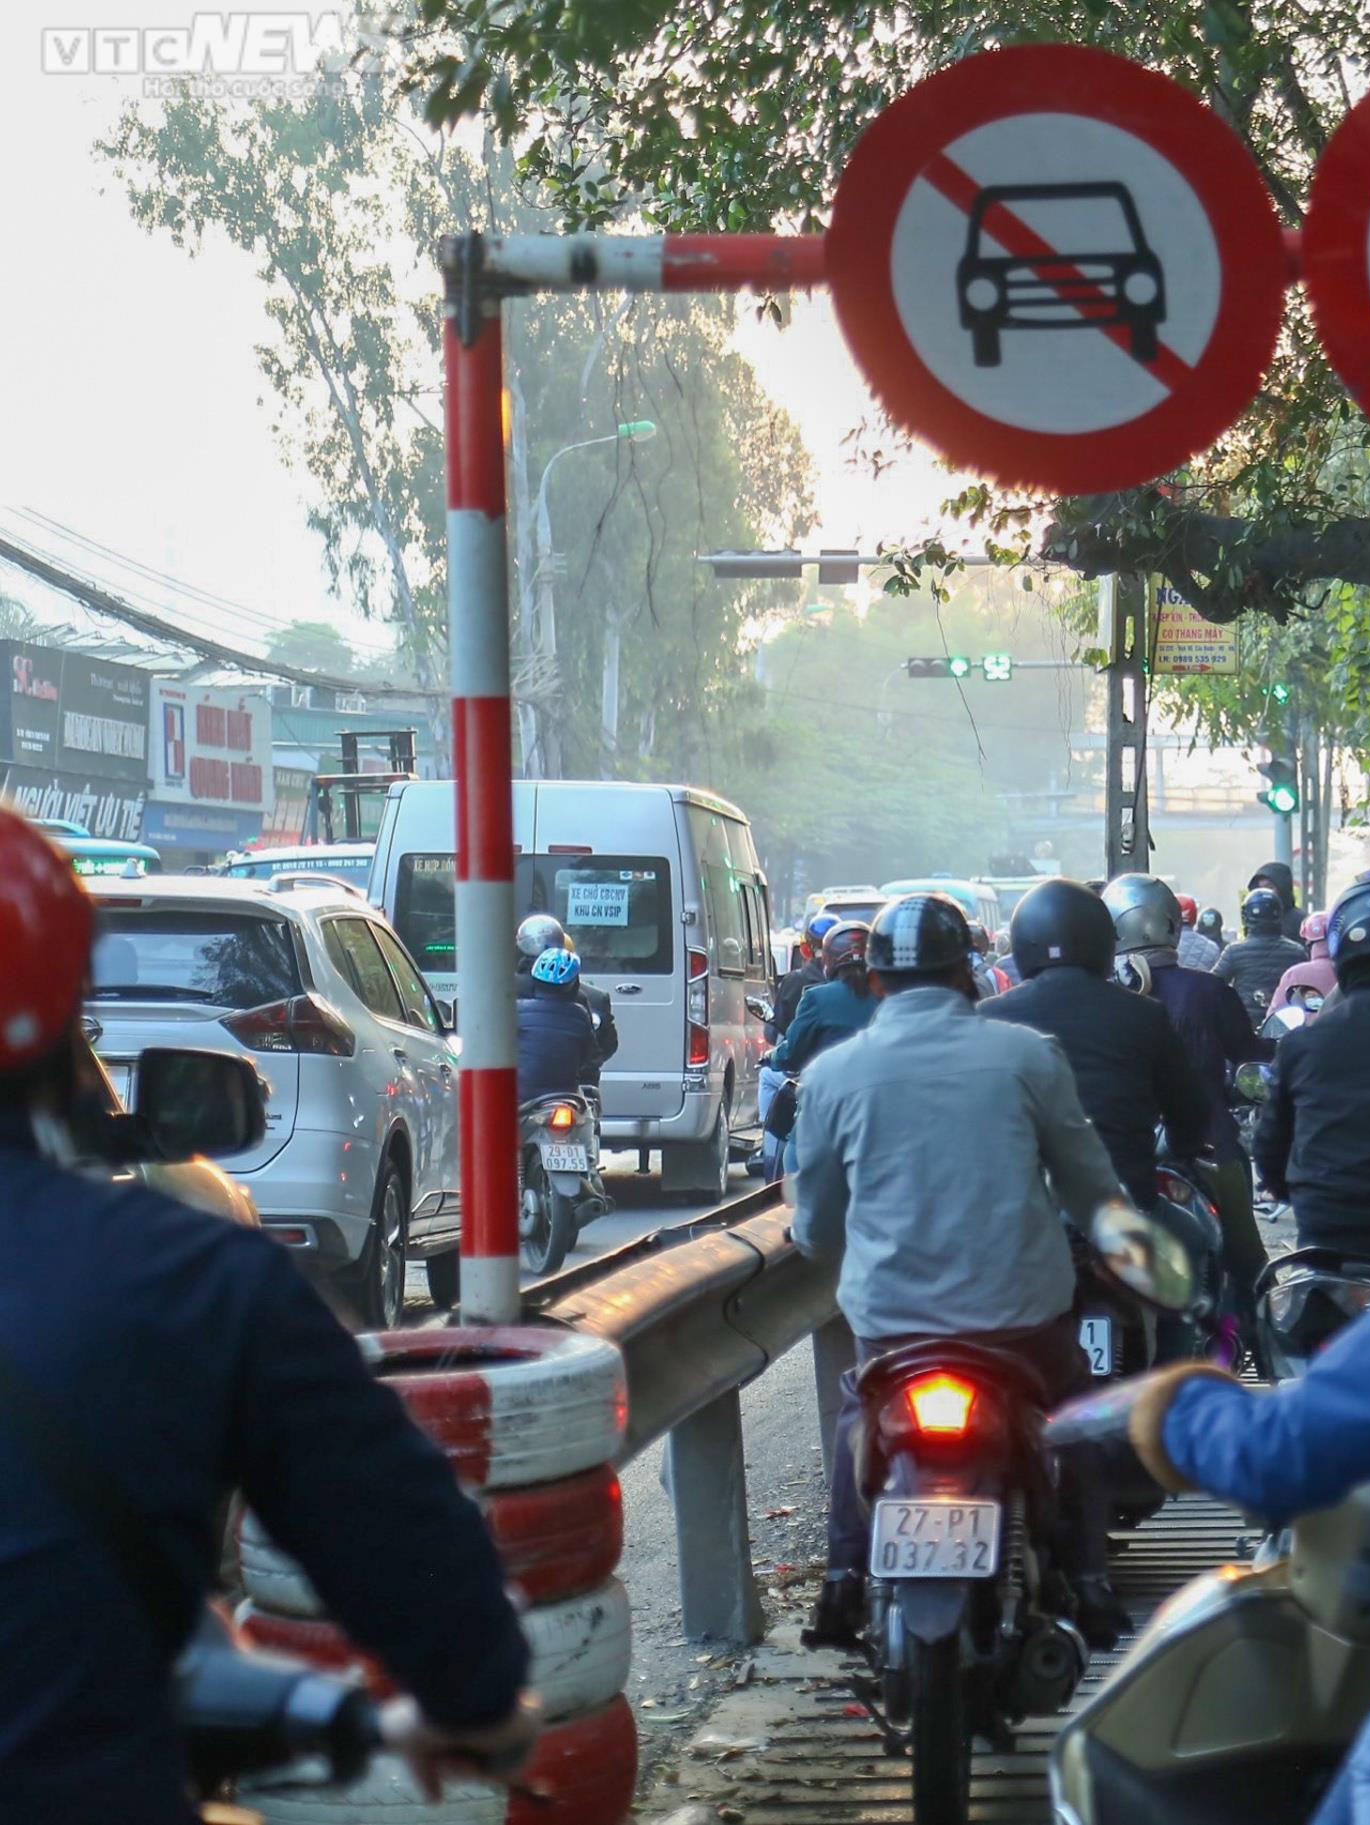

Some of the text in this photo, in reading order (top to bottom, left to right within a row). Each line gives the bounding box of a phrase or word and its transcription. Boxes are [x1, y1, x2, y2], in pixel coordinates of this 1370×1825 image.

[546, 1158, 586, 1170] 097.55
[897, 1508, 980, 1534] 27-P1
[882, 1540, 989, 1571] 037.32
